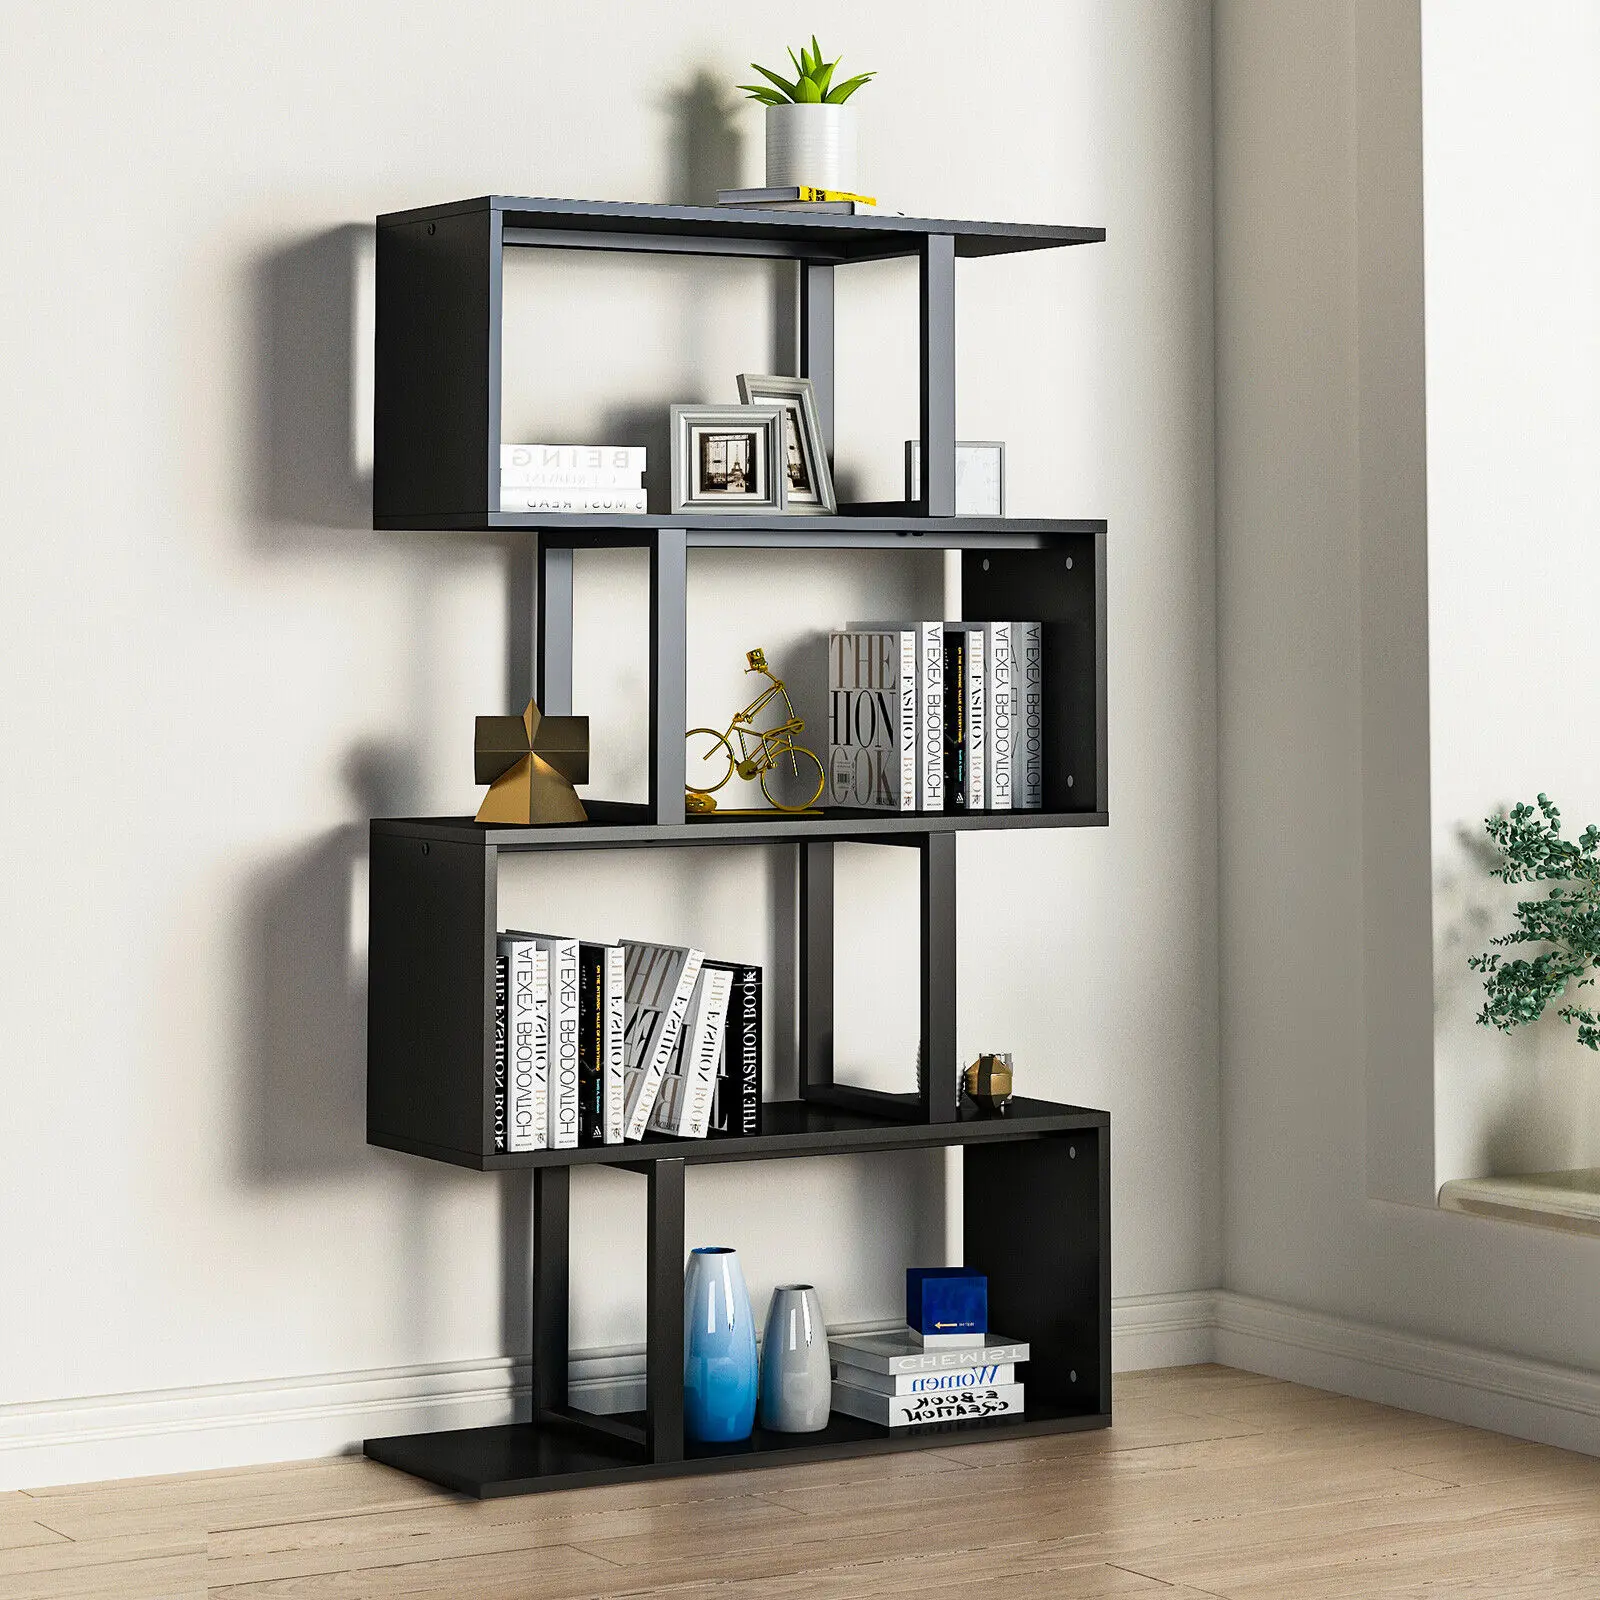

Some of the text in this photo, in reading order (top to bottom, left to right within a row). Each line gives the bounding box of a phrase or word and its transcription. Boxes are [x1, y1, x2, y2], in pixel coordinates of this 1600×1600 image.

[830, 633, 896, 690] THE
[903, 633, 913, 671] THE
[957, 646, 963, 655] ON
[971, 634, 982, 671] THE
[903, 676, 913, 752] FASHION
[971, 675, 982, 750] FASHION
[596, 964, 601, 974] ON
[595, 1029, 601, 1037] OF
[743, 971, 757, 1132] THE FASHION BOOK
